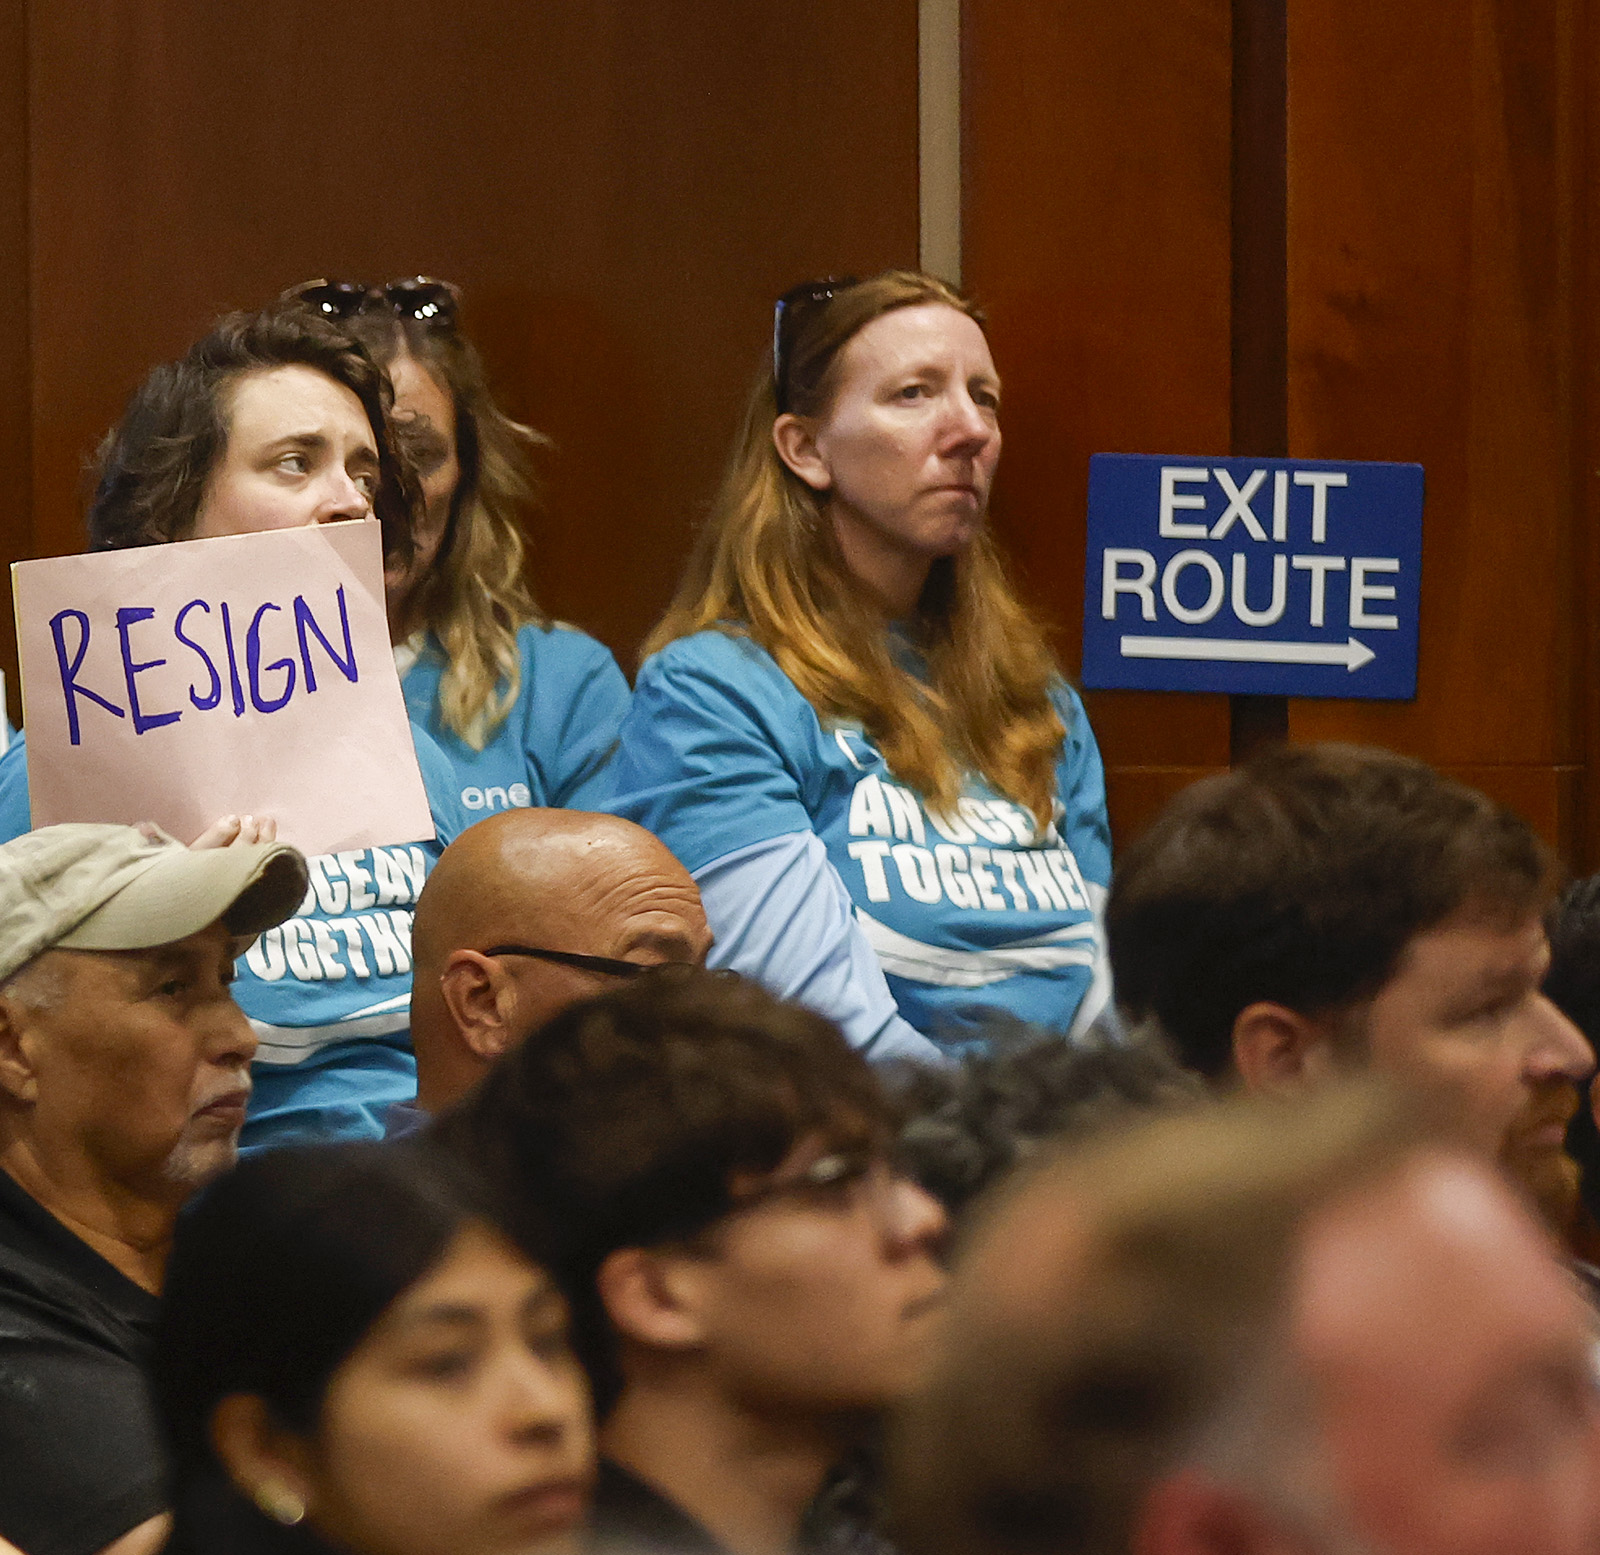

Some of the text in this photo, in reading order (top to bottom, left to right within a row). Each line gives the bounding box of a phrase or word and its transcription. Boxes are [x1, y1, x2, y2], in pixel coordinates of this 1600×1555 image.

[1158, 465, 1348, 543] EXIT
[1101, 547, 1401, 630] ROUTE
[49, 582, 359, 746] RESIGN
[460, 782, 531, 810] one
[848, 774, 926, 846] AN
